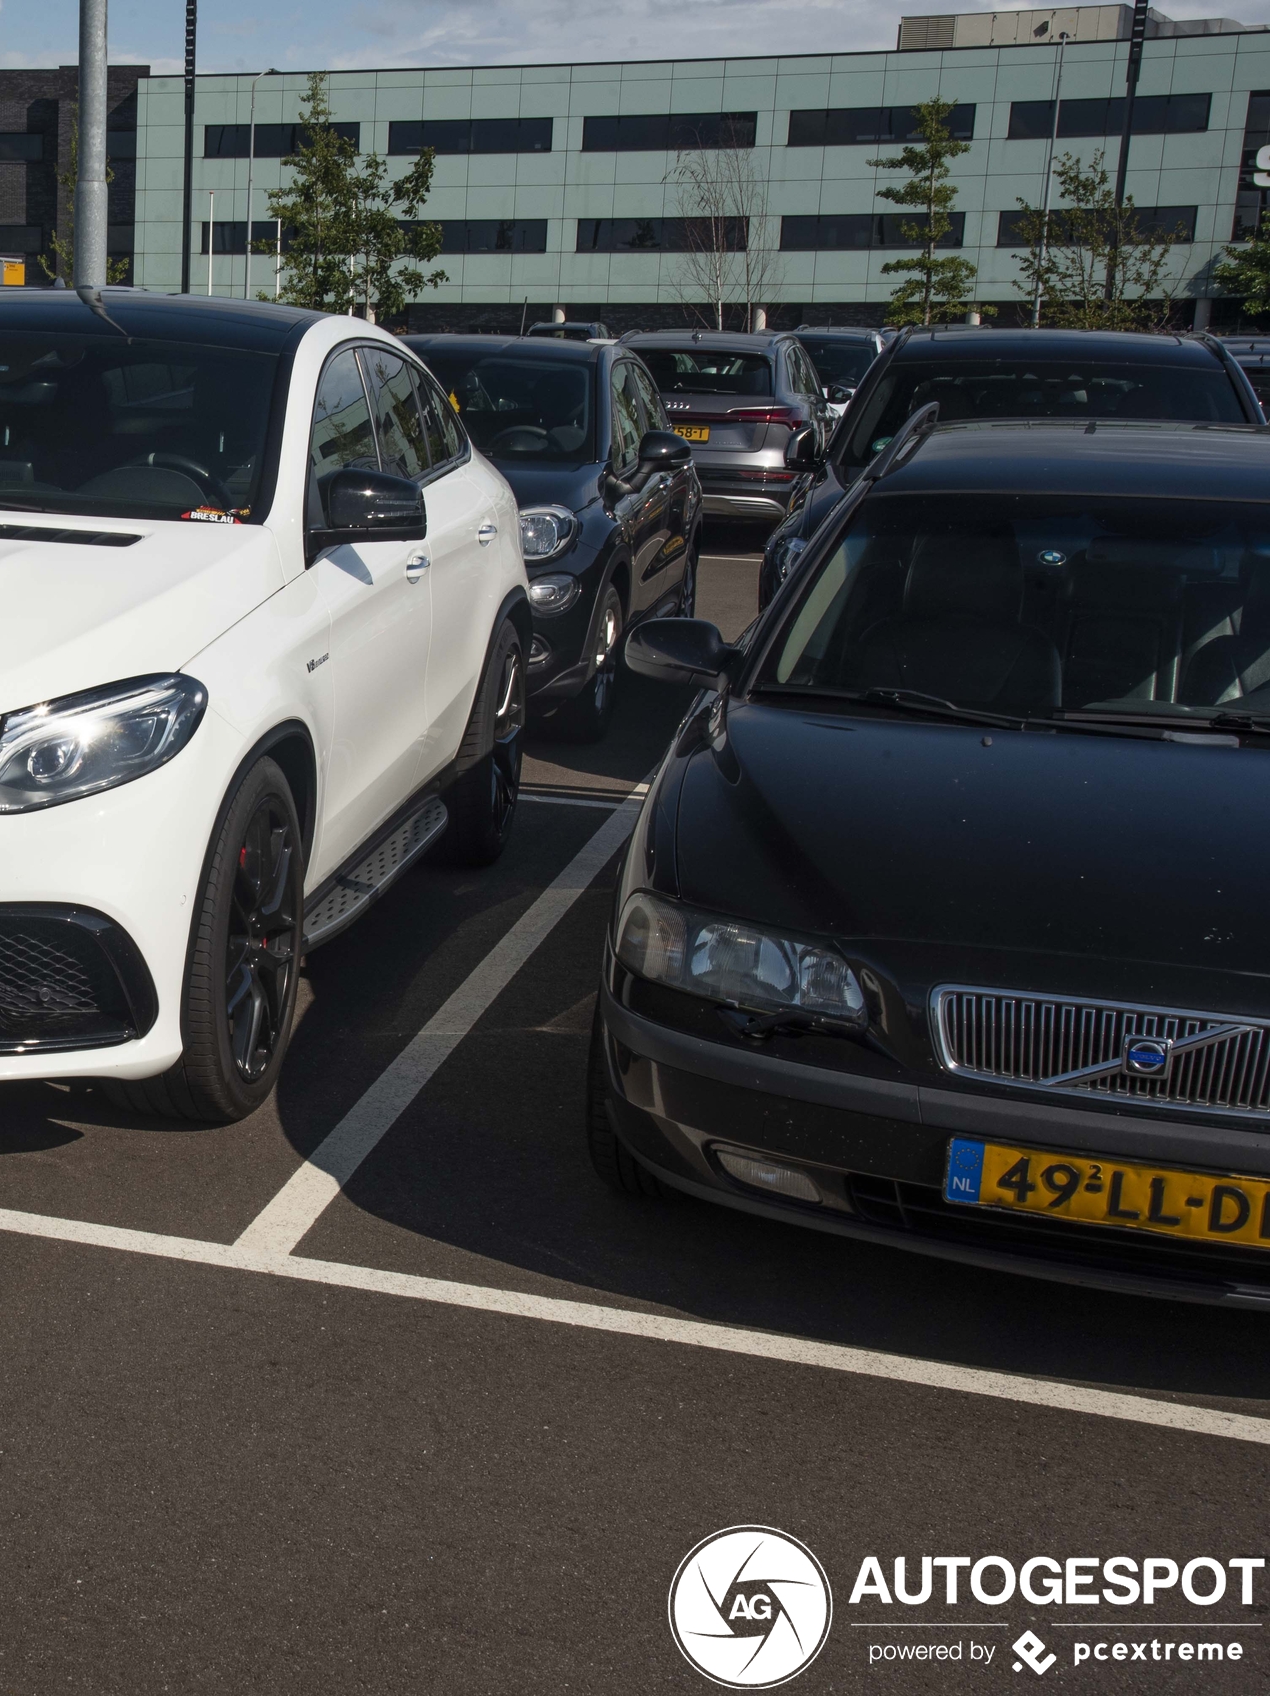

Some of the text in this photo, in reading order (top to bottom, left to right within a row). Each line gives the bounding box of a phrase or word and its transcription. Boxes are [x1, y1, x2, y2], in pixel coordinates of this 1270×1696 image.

[672, 427, 705, 438] 58-T
[190, 511, 234, 523] BRESLAU
[952, 1176, 976, 1193] NL
